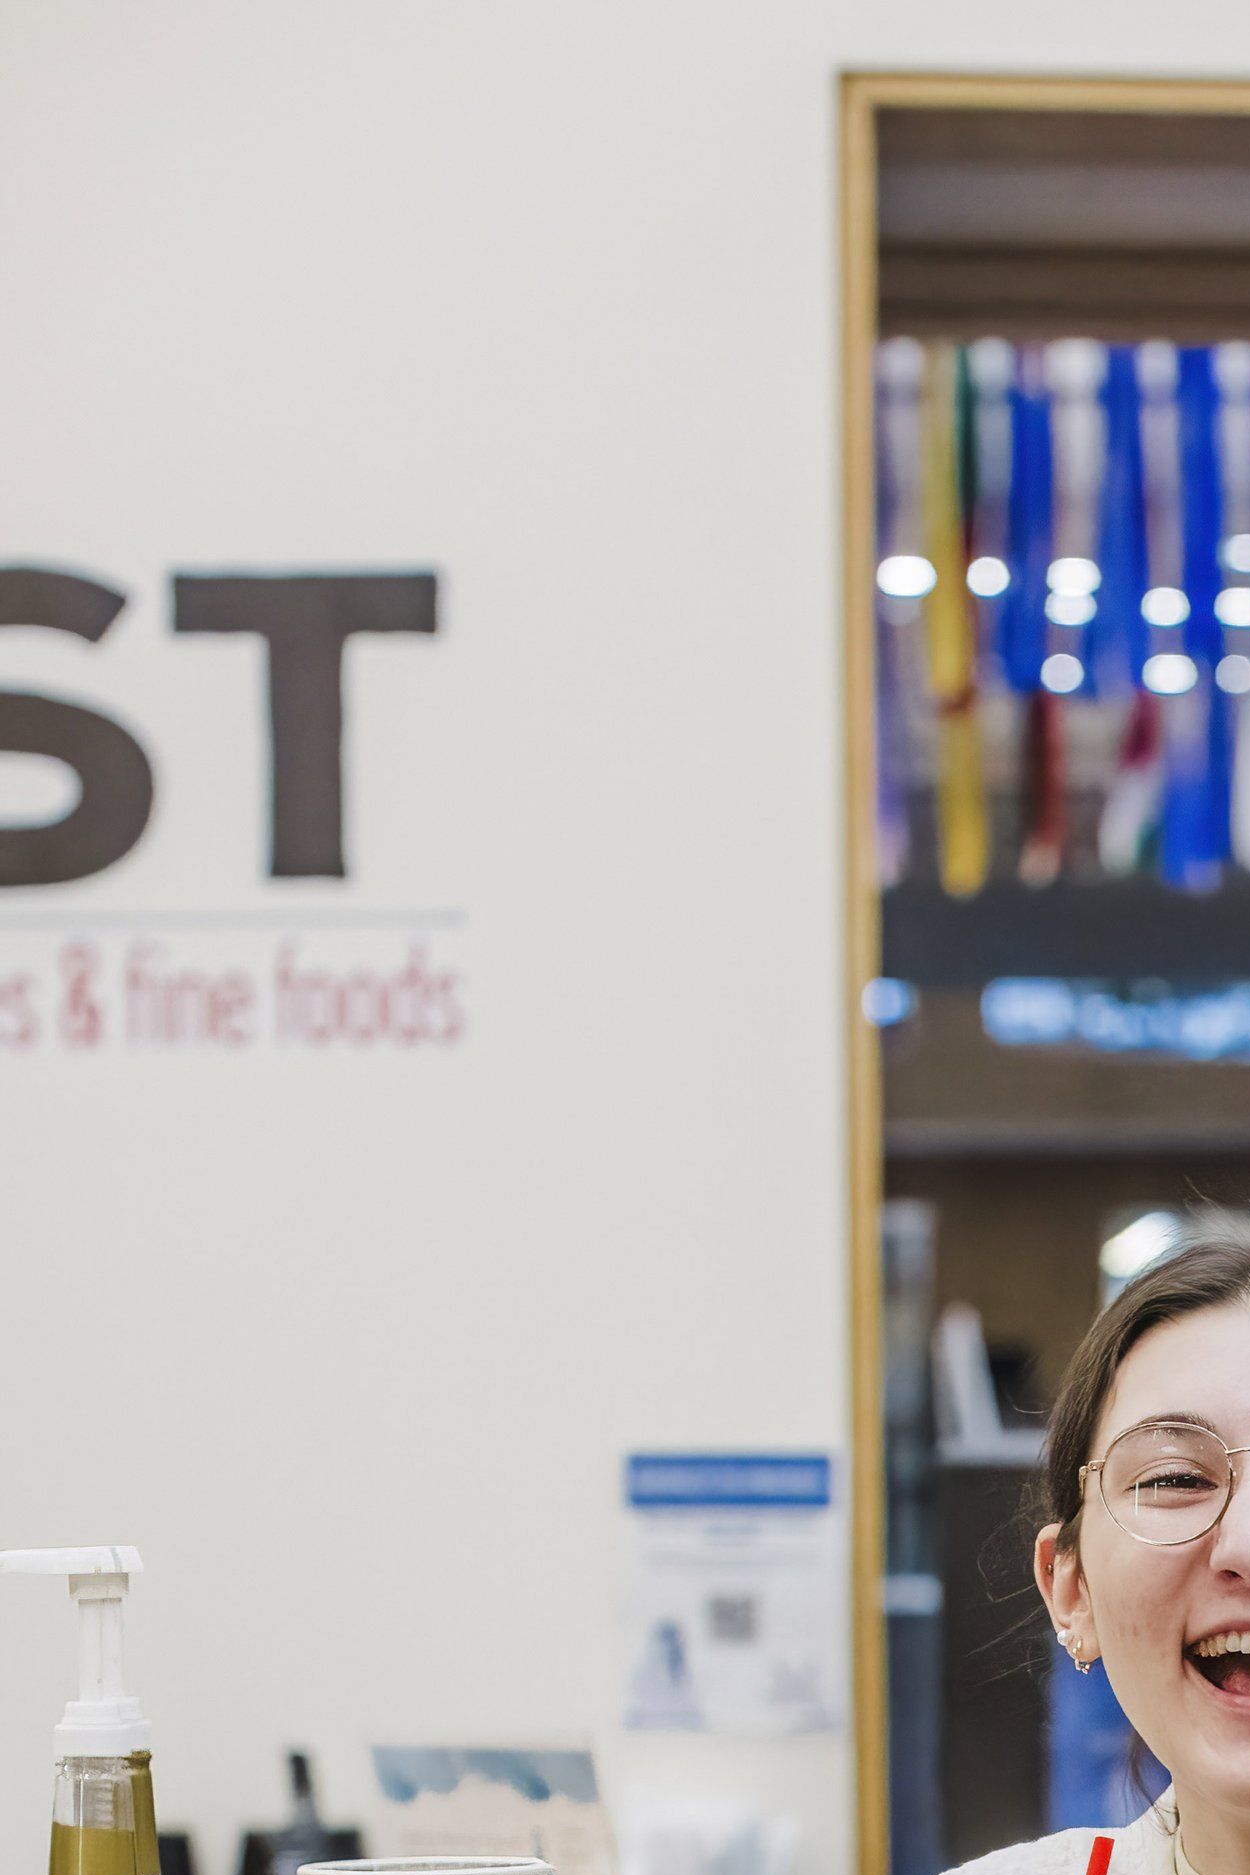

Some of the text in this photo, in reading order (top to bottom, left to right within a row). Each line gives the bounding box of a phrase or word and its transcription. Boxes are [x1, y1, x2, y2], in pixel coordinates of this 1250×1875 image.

[0, 567, 437, 888] ST
[59, 940, 102, 1047] &
[123, 938, 255, 1046] fine
[274, 935, 466, 1048] foods
